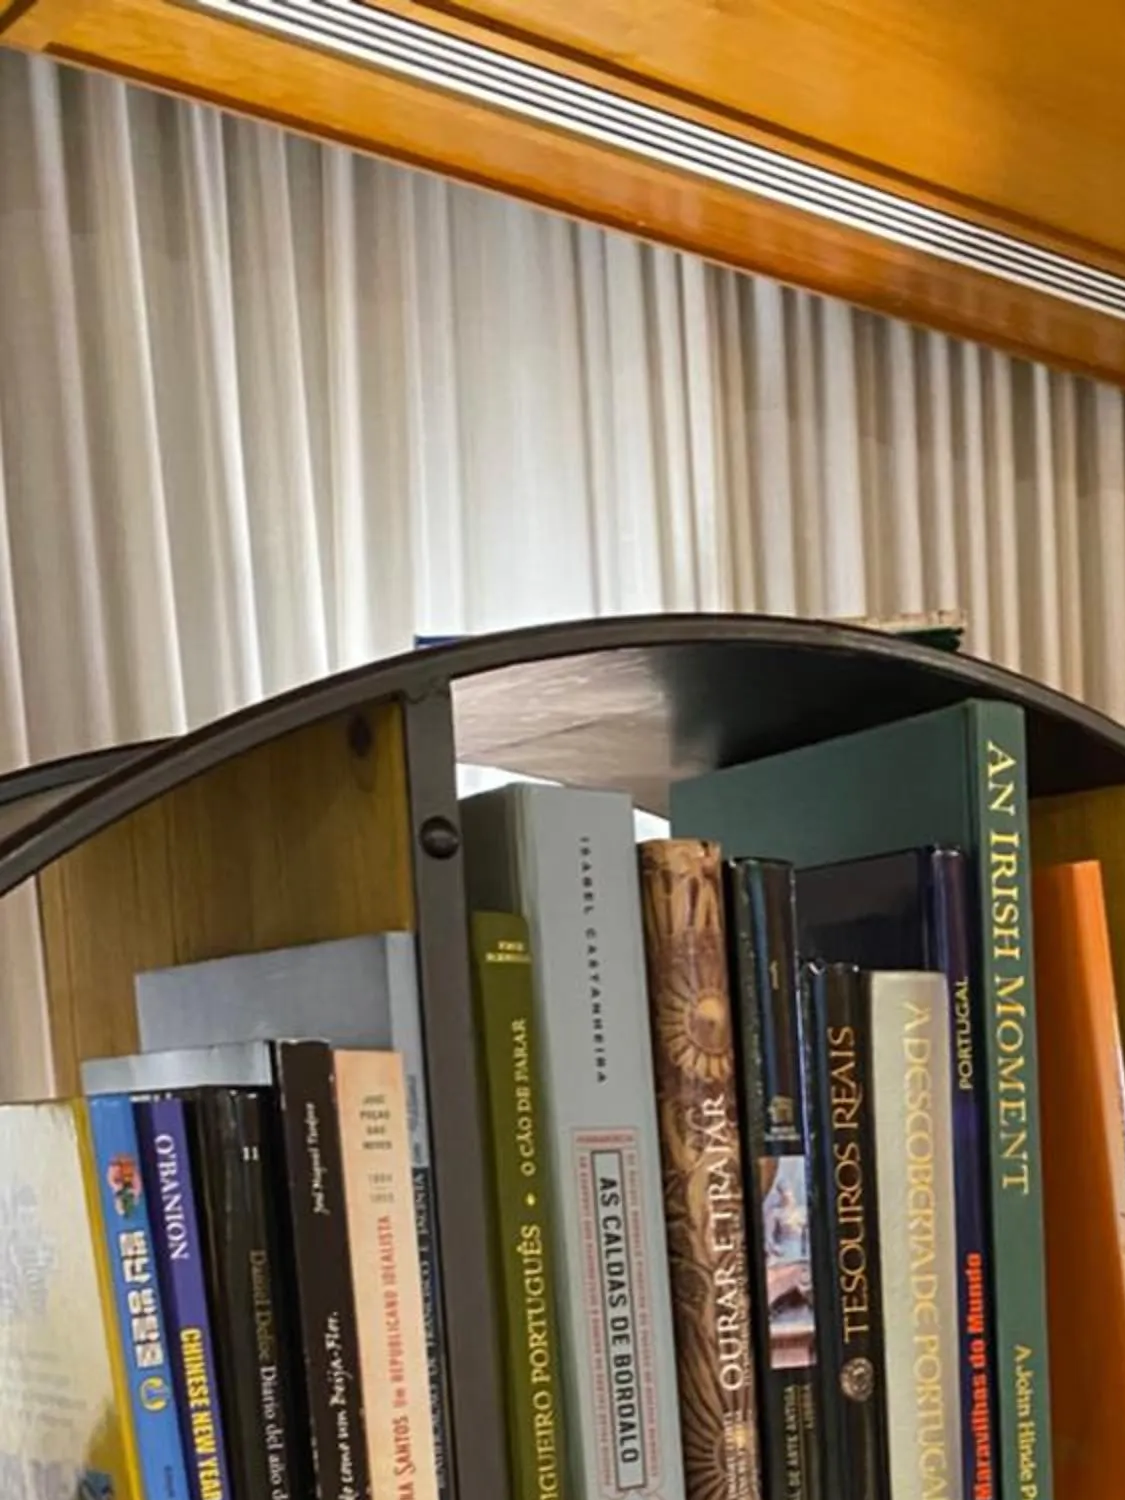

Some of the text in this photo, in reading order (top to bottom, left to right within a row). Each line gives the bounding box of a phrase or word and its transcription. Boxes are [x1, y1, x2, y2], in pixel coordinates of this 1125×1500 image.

[988, 740, 1030, 1194] AN IRISH MOMENT
[902, 1002, 933, 1031] A
[954, 976, 974, 1090] PORTUGAL
[510, 1019, 530, 1083] PARAR
[515, 1087, 532, 1113] DE
[827, 1026, 870, 1343] TESOUROS REAIS
[902, 1038, 936, 1271] DESCOBERTA
[154, 1133, 189, 1261] O'BANION
[377, 1215, 396, 1286] IDEALISTA
[525, 1224, 552, 1384] PORTUGUÊS
[599, 1177, 641, 1462] AS CALDAS DE BORDALO
[911, 1274, 939, 1323] DE
[966, 1253, 984, 1334] Mundo
[180, 1325, 212, 1407] CHINESE
[970, 1340, 987, 1368] do
[1014, 1346, 1031, 1362] A
[259, 1364, 281, 1420] Diario
[1015, 1365, 1033, 1416] John
[191, 1411, 216, 1454] NEW
[266, 1423, 285, 1450] del
[391, 1416, 416, 1477] SANTOS
[1018, 1421, 1037, 1480] Hinde
[268, 1454, 287, 1487] año
